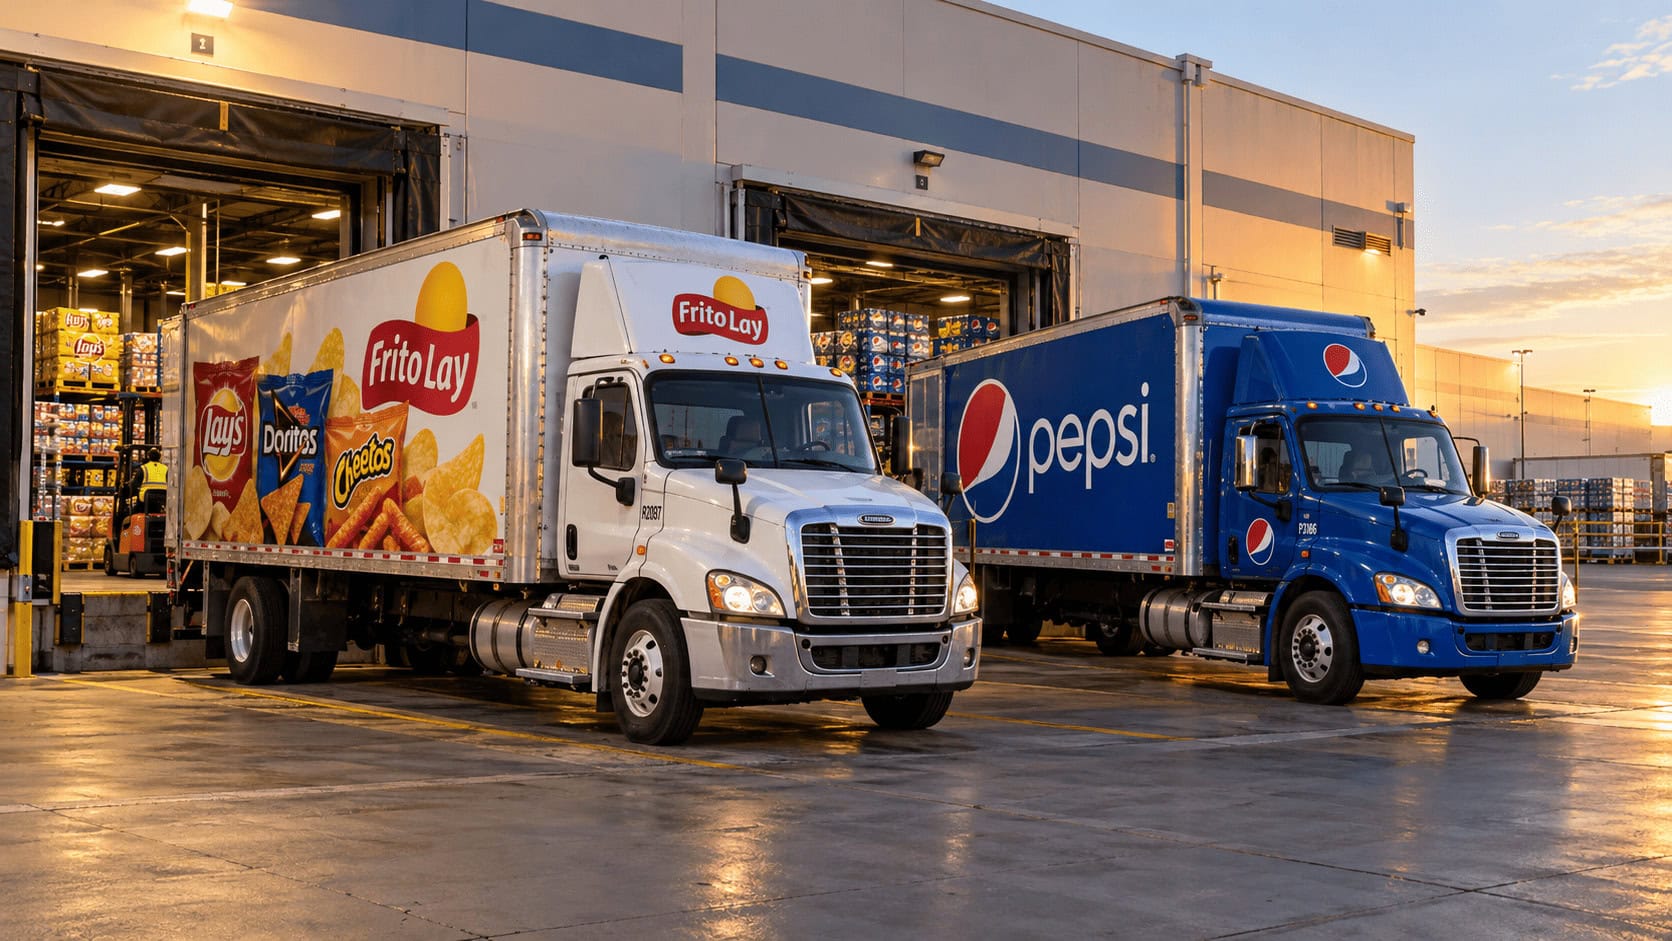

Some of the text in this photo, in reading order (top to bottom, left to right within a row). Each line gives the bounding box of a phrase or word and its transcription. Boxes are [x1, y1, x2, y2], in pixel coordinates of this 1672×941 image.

[679, 301, 763, 341] Frito Lay
[369, 333, 470, 403] Frito Lay
[202, 408, 245, 456] Lay's
[262, 424, 318, 456] Doritos
[1027, 381, 1150, 495] pepsi
[333, 434, 395, 508] Cheetos
